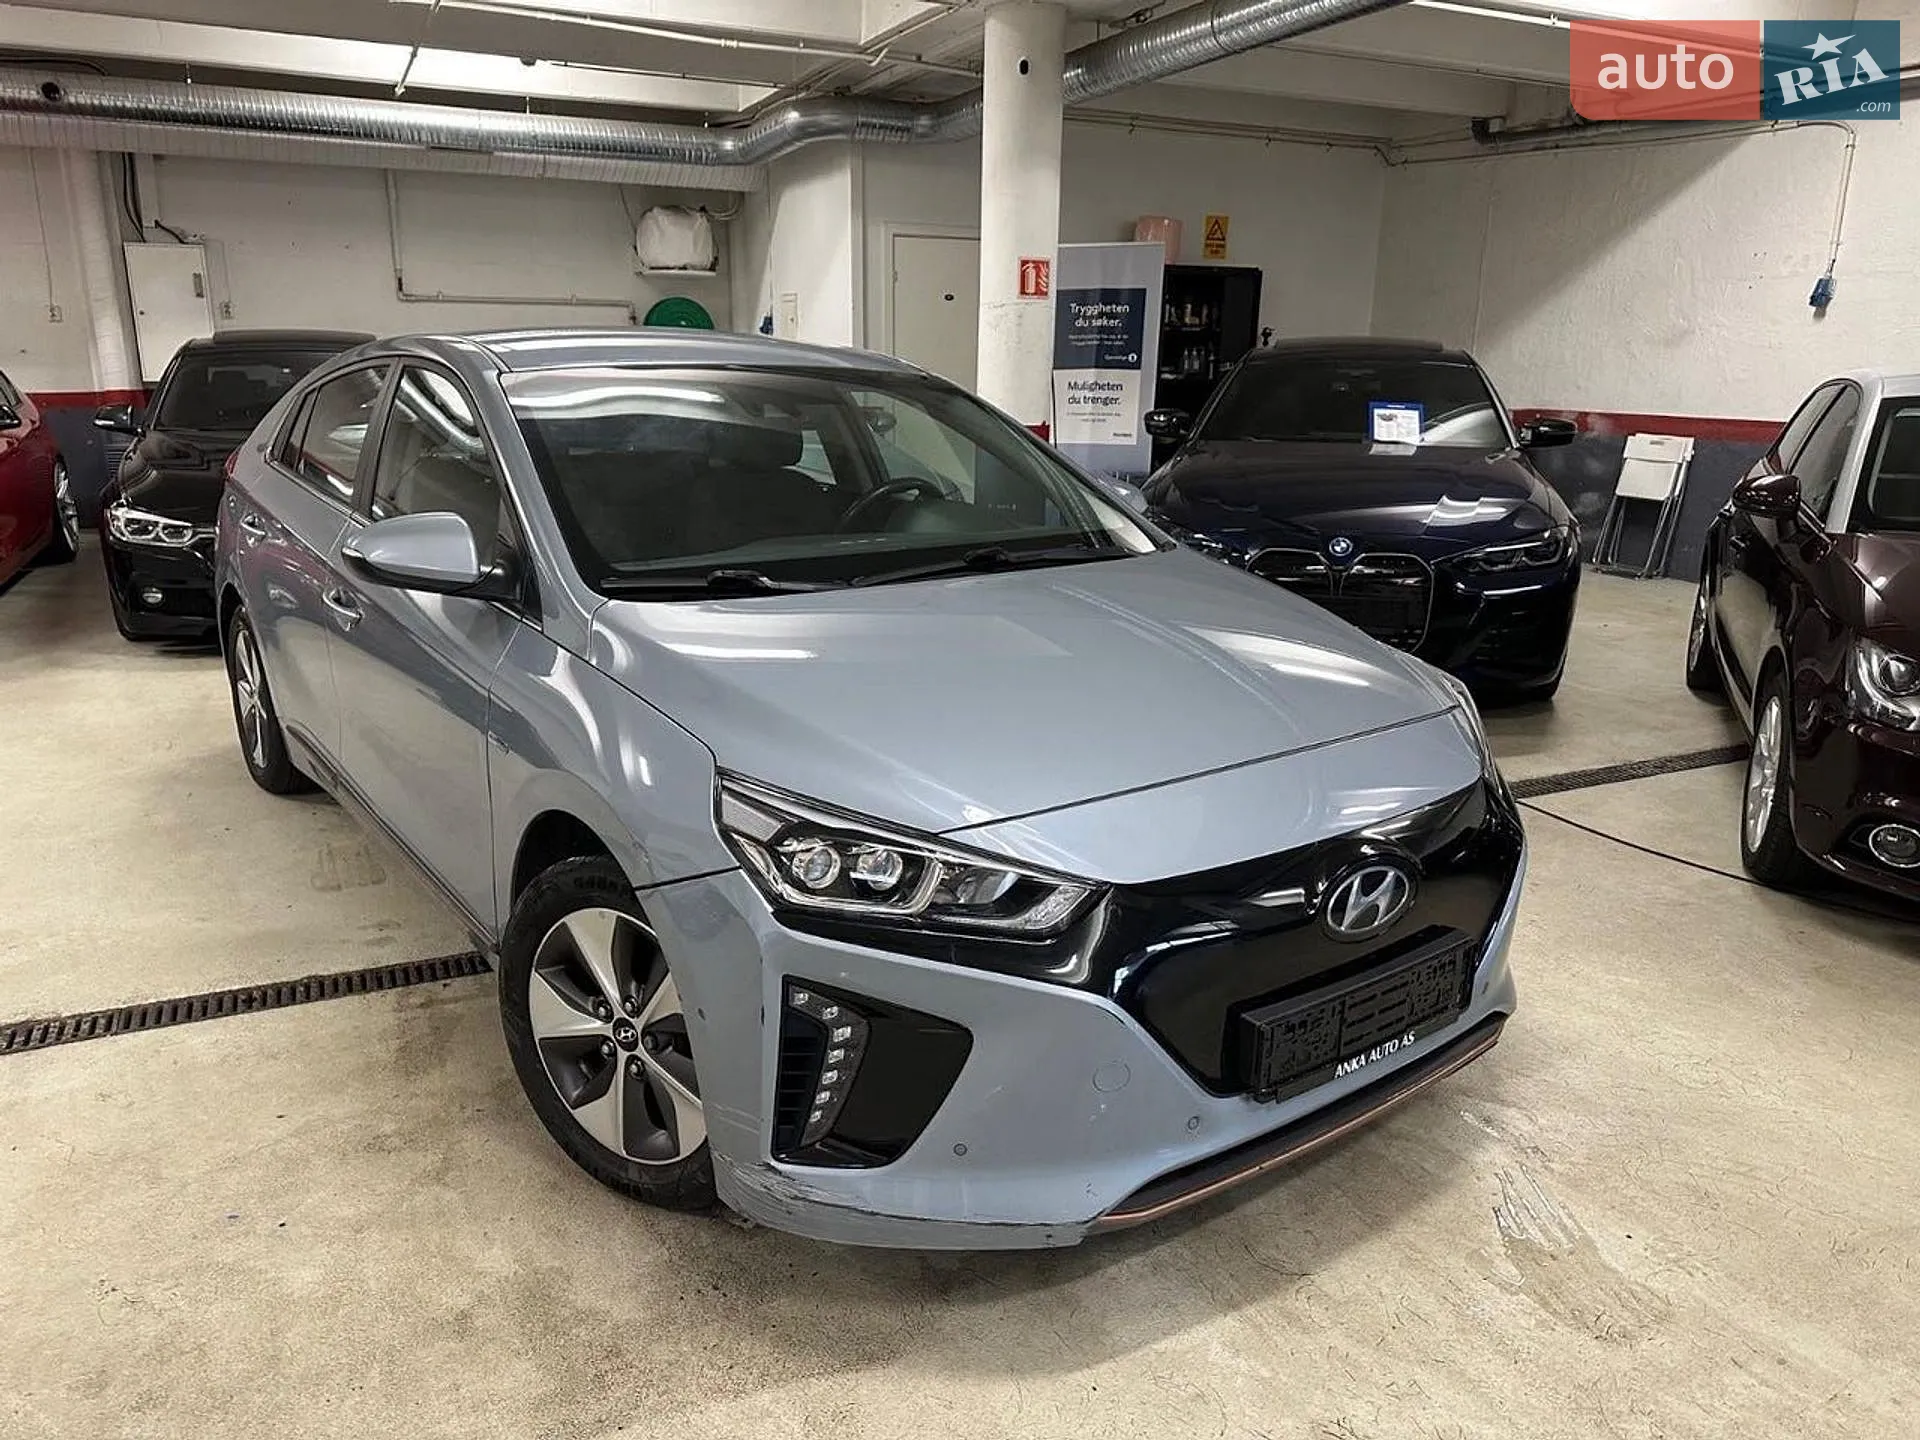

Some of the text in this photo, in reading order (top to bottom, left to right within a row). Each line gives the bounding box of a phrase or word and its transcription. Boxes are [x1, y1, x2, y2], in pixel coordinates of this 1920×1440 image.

[1070, 303, 1130, 316] Tryggheten
[1075, 316, 1122, 327] du søker.
[1067, 380, 1123, 392] Muligheten
[1068, 394, 1121, 406] du trenger.
[1334, 1030, 1416, 1079] ANKA AUTO AS
